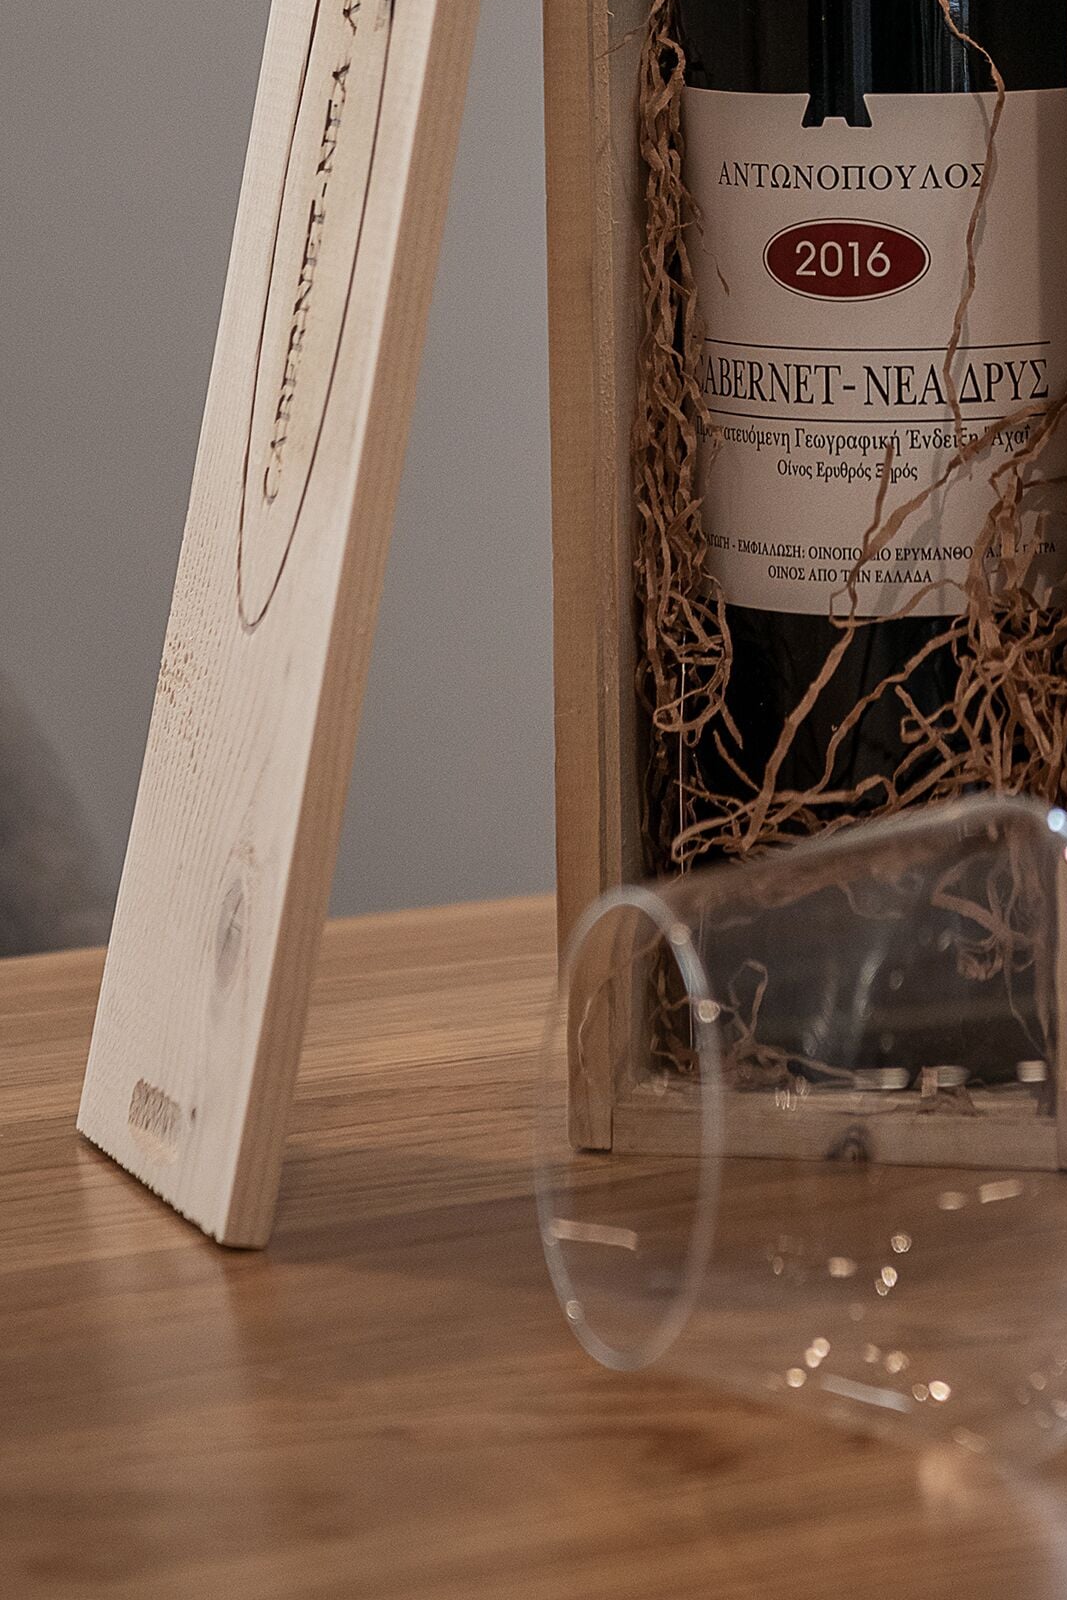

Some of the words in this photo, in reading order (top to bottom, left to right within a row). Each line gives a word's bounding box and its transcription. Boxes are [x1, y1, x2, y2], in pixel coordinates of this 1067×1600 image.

[718, 160, 985, 191] ΑΝΤΩΝΟΠΟΥΛΟΣ
[795, 241, 891, 278] 2016
[959, 358, 1049, 404] ΔΡΥΣ
[795, 427, 901, 457] Γεωγραφική
[777, 458, 813, 480] Οίνος
[816, 461, 872, 483] Ερυθρός
[738, 539, 805, 559] ΕΜΦΙΑΛΩΣΗ:
[768, 565, 806, 581] ΟΙΝΟΣ
[808, 568, 838, 582] ΑΠΟ
[875, 569, 933, 584] ΕΛΛΑΔΑ
